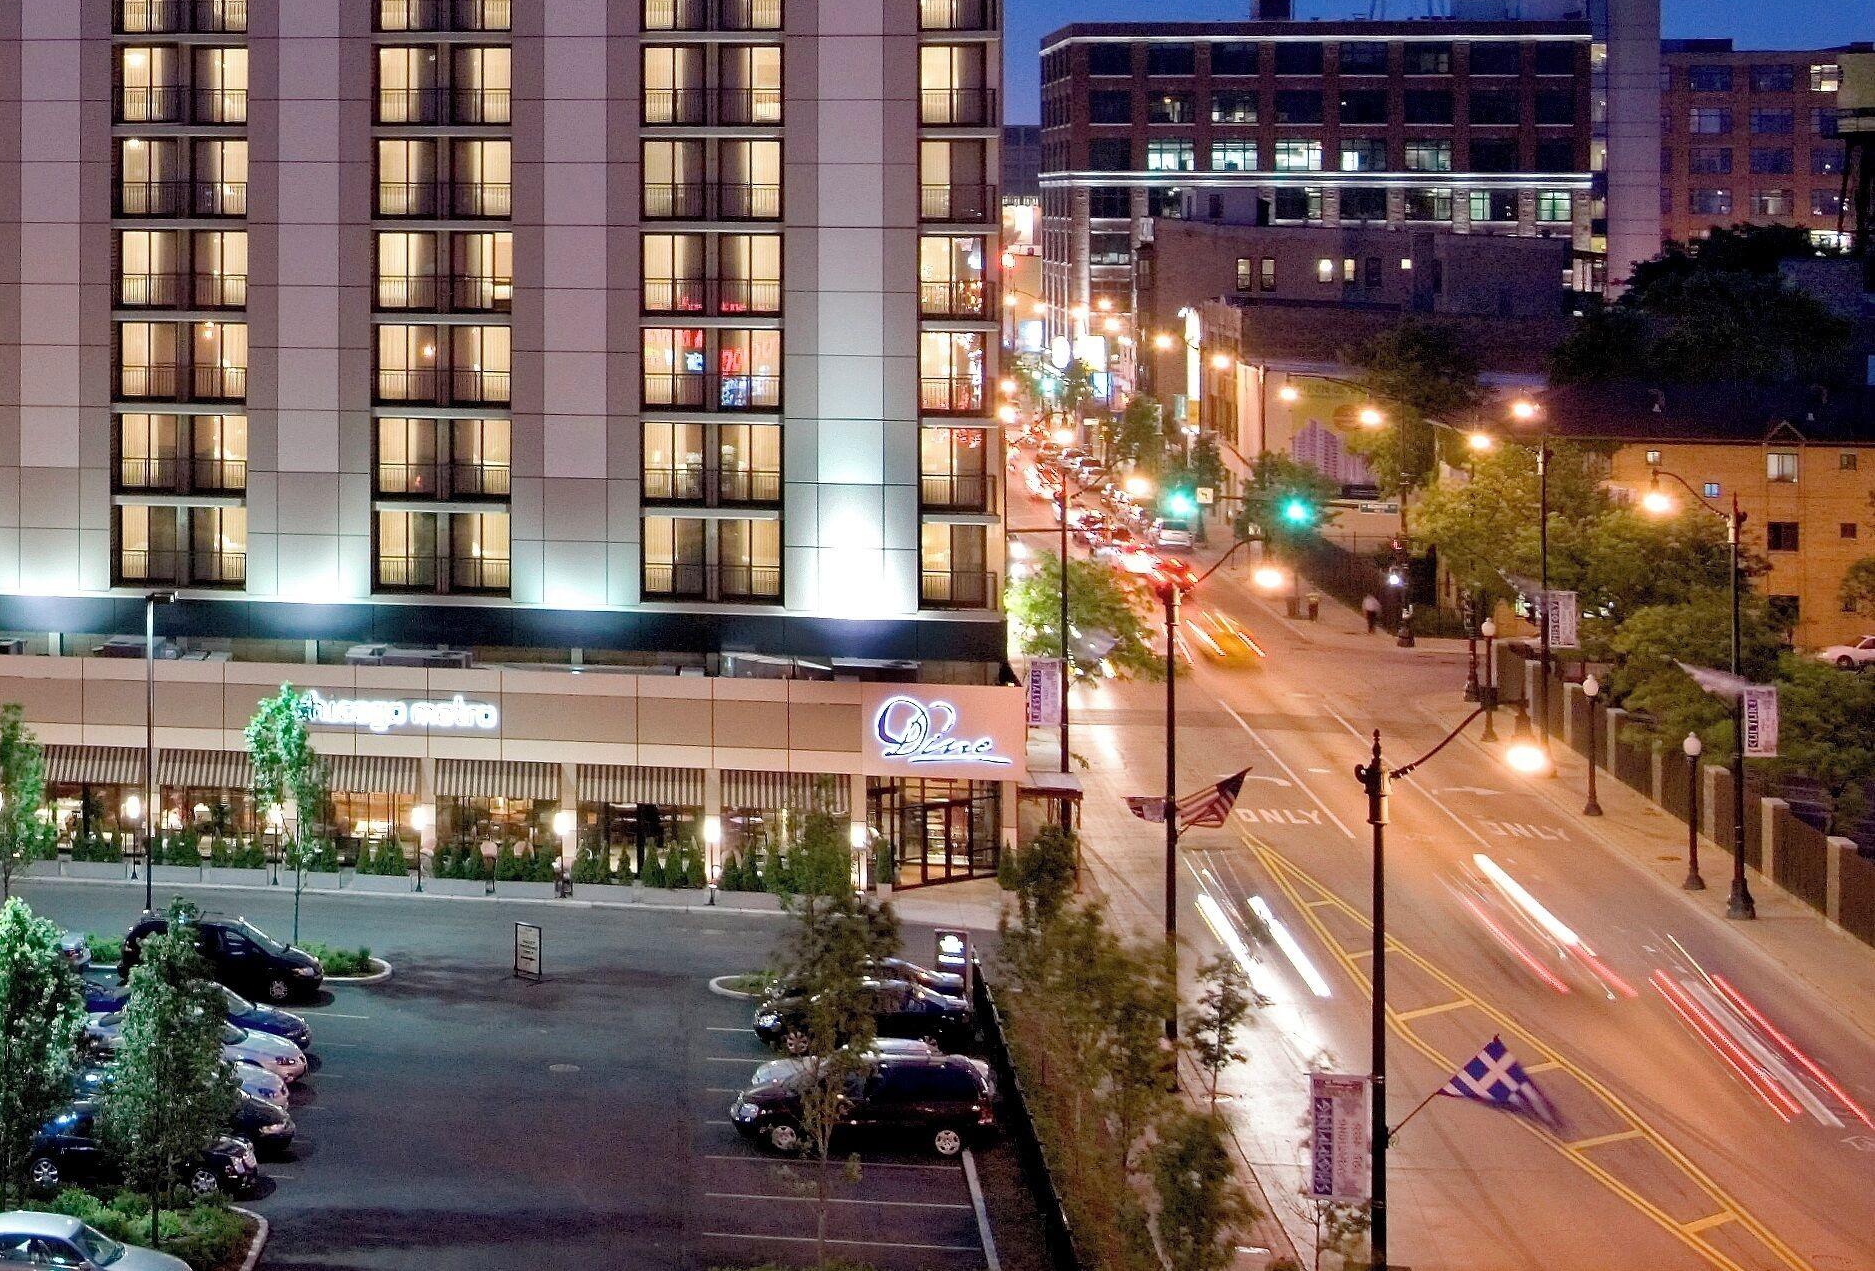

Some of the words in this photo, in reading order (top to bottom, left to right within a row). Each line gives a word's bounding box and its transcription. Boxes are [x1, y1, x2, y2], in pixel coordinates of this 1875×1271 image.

[875, 695, 1012, 764] Dine
[1748, 699, 1758, 747] CULTURE
[1235, 808, 1322, 825] ONLY
